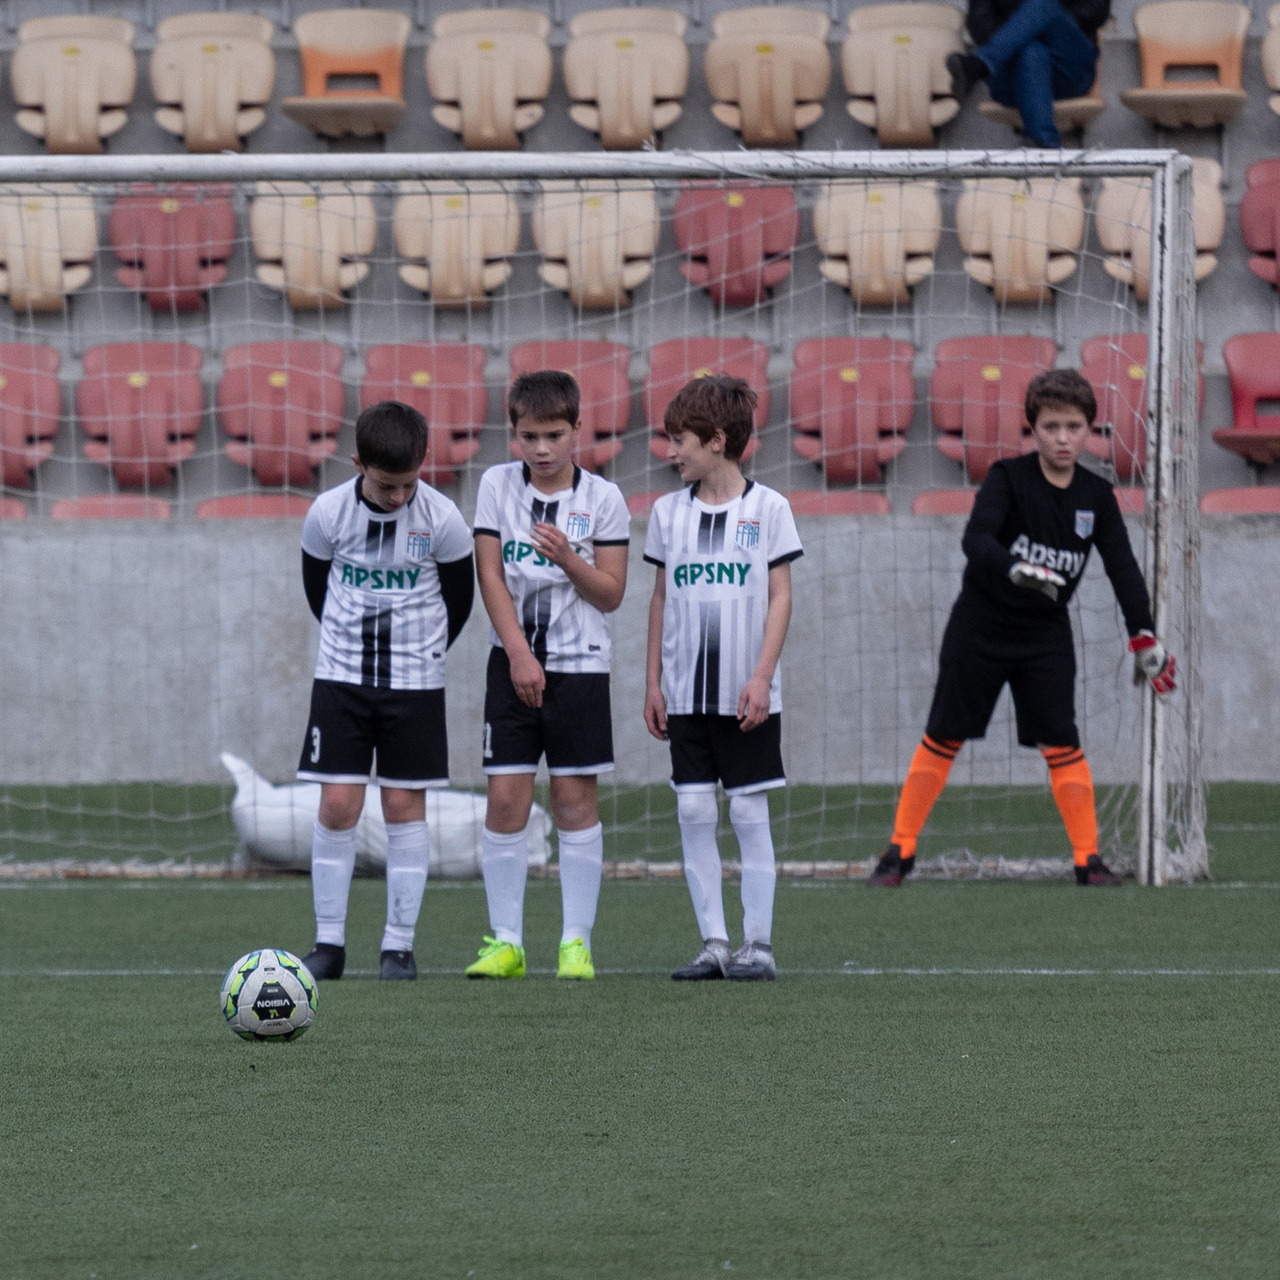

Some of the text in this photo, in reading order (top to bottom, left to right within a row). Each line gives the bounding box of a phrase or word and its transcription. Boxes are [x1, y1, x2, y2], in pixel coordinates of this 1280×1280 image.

[503, 540, 582, 567] APS
[1010, 533, 1085, 578] Apsny
[341, 563, 421, 590] APSNY
[674, 562, 752, 589] APSNY
[311, 726, 321, 764] 3
[257, 999, 290, 1008] VISION
